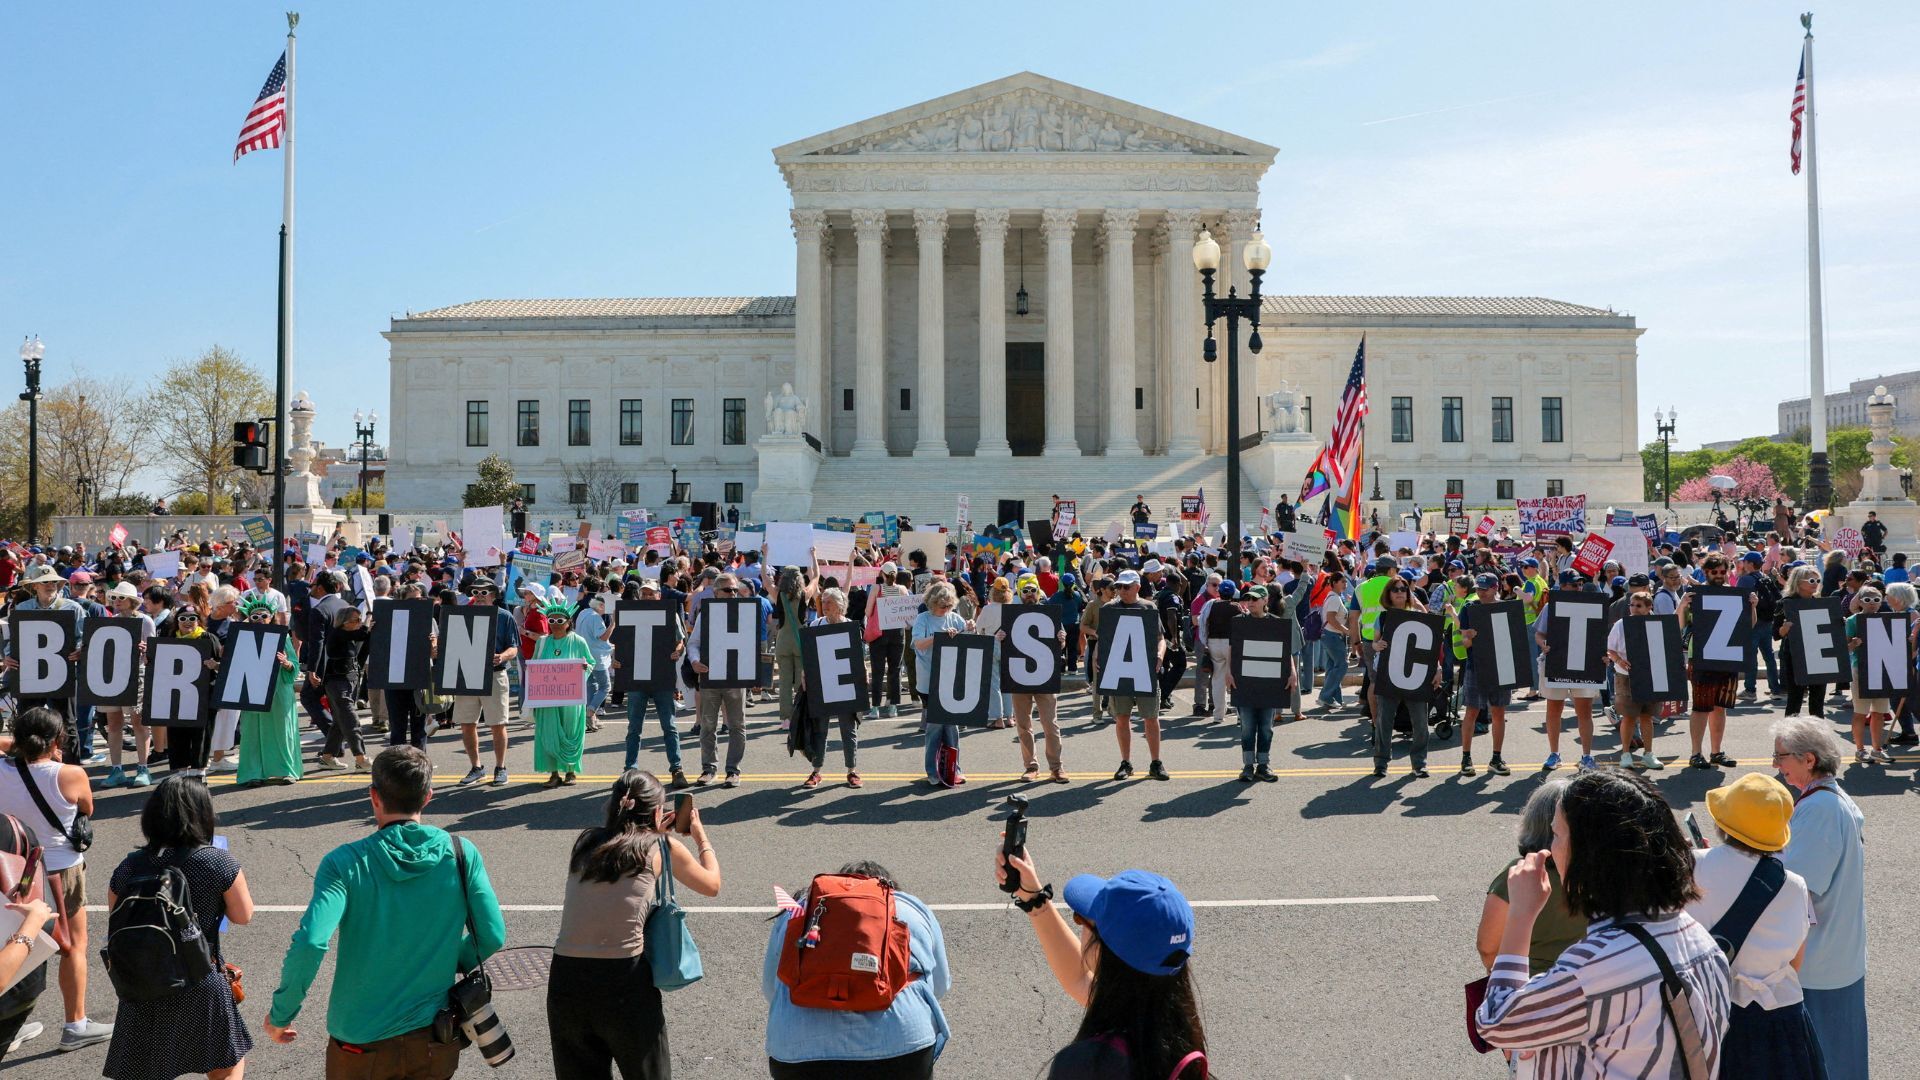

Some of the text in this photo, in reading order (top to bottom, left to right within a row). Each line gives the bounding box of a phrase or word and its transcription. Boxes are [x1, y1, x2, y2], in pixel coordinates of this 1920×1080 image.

[1520, 518, 1585, 534] IMMIGRANTS
[1837, 528, 1858, 539] STOP
[1584, 540, 1609, 558] BIRTH
[1833, 539, 1862, 549] RACISM
[1580, 548, 1604, 565] RIGHT
[18, 620, 281, 720] BORN
[388, 609, 491, 690] IN
[618, 602, 855, 704] THE
[938, 611, 1154, 714] USA
[1387, 594, 1909, 693] CITIZEN
[531, 664, 574, 673] CITIZENSHIP
[528, 683, 576, 696] BIRTHRIGHT
